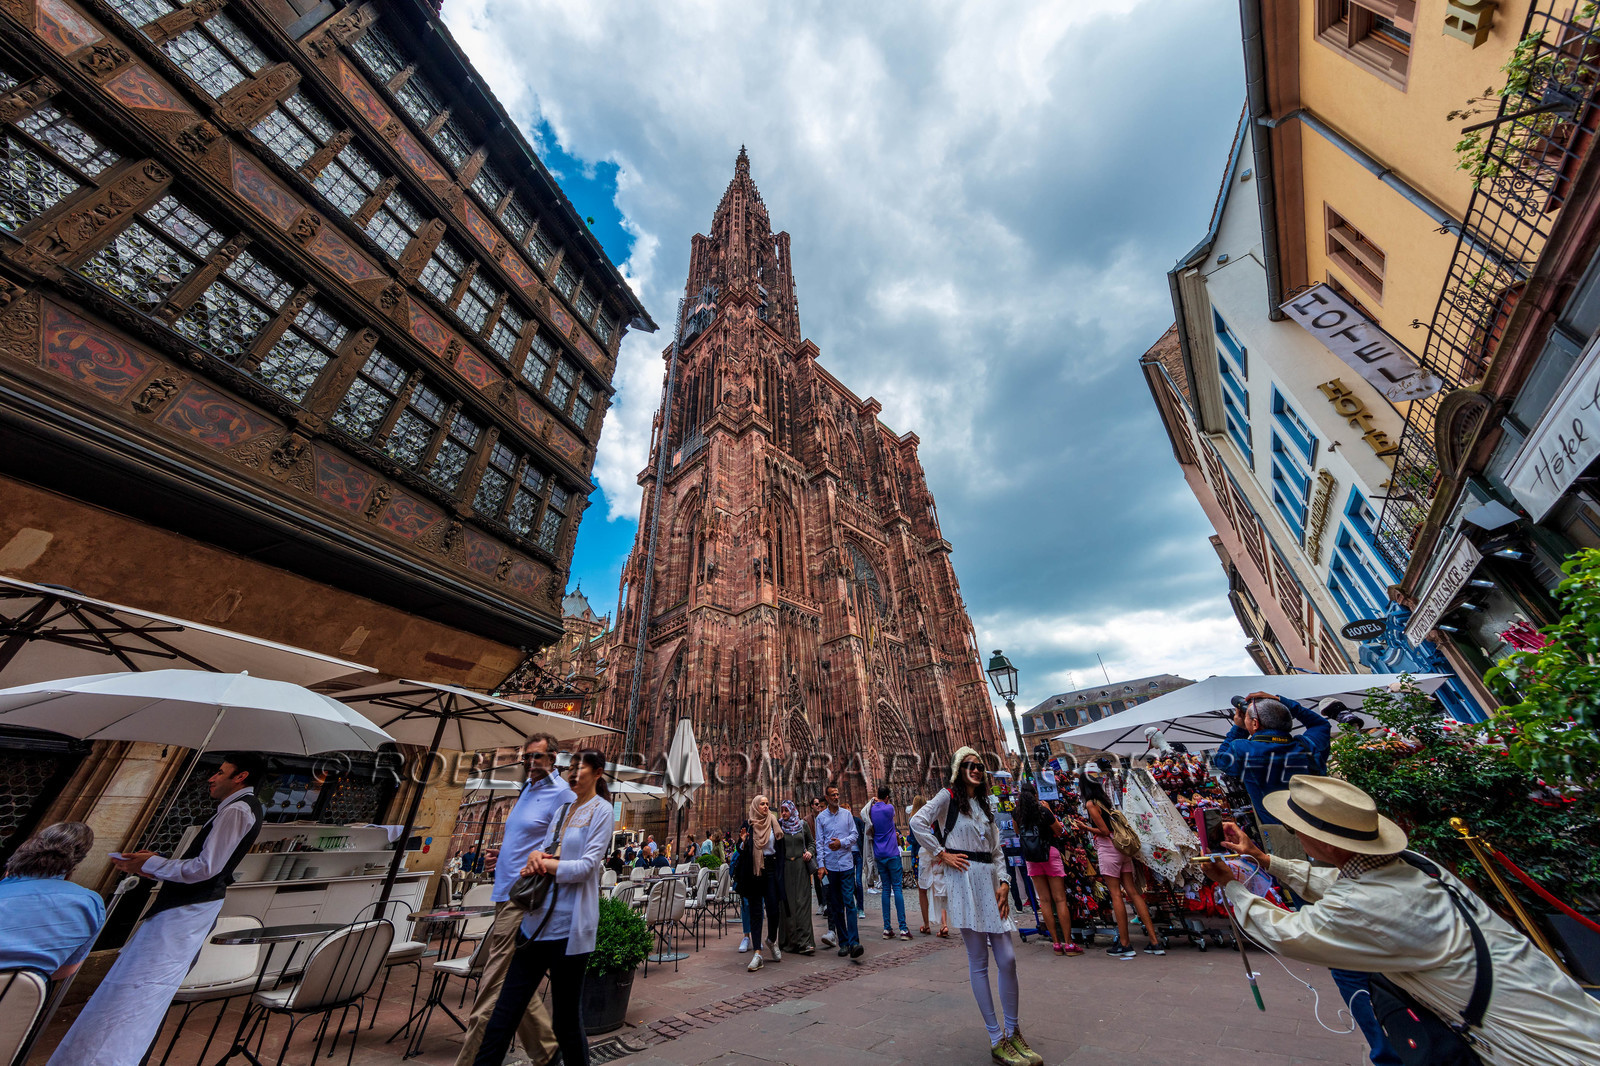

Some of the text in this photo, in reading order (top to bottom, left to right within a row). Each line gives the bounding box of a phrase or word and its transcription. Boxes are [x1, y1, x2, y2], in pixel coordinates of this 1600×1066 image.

[1291, 293, 1416, 383] HOTEL
[1317, 377, 1412, 475] HOTEL
[1346, 623, 1382, 638] HOTEL
[1410, 605, 1438, 643] SOUVENIRS
